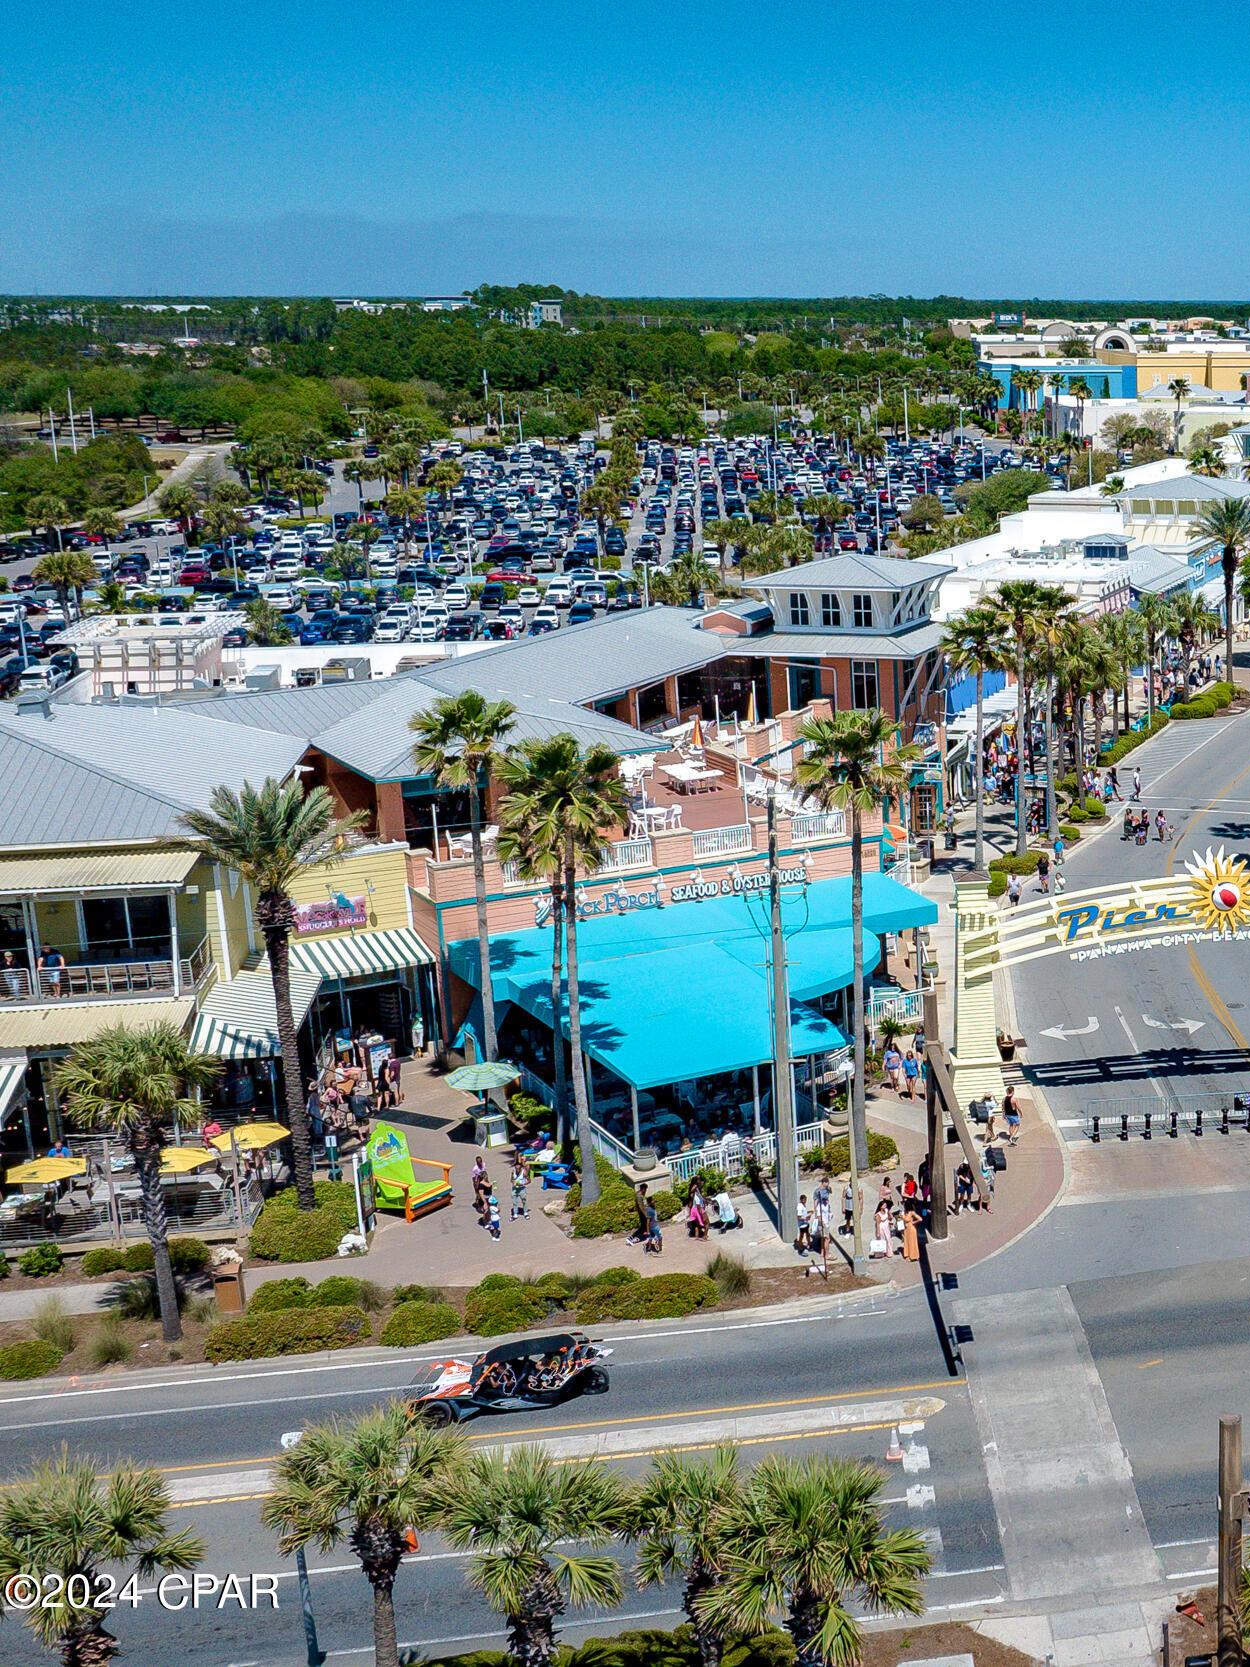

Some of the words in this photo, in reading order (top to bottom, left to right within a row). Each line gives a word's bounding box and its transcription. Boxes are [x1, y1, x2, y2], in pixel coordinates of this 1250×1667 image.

[671, 880, 719, 902] SEAFOOD
[721, 880, 732, 894] &
[733, 872, 772, 892] OYSTER
[560, 898, 603, 916] ACK
[602, 890, 663, 913] PORCH
[1056, 901, 1192, 943] Pier
[1077, 937, 1153, 962] PANAMA
[1162, 930, 1205, 948] CITY
